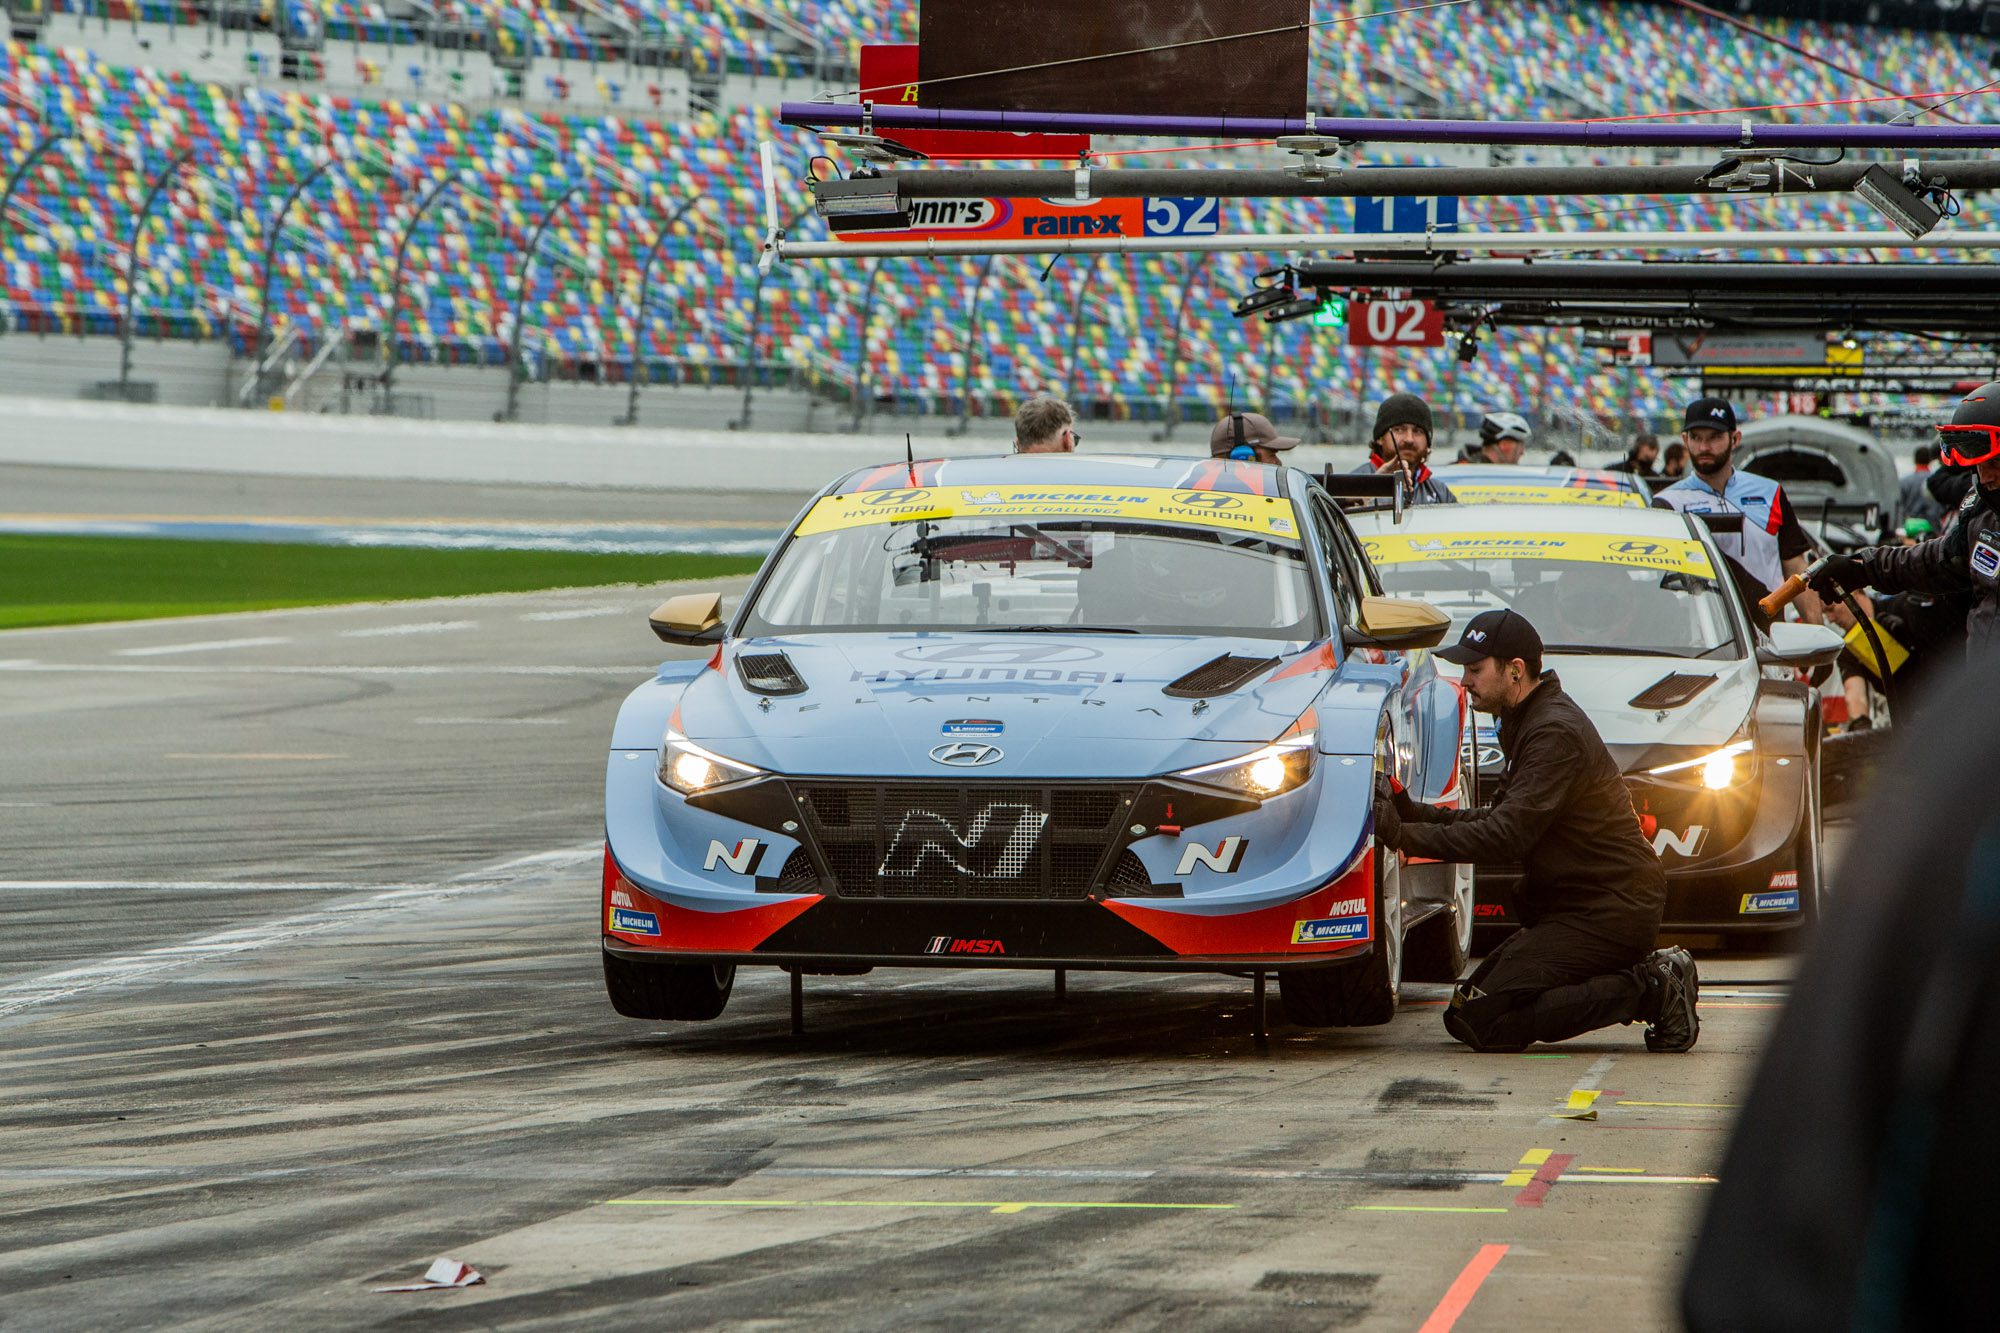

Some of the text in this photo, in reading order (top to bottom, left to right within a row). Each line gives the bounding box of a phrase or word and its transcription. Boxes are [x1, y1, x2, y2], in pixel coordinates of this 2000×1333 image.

[1146, 197, 1217, 234] 52
[1367, 299, 1426, 342] 02
[1010, 493, 1149, 505] MICHELIN
[843, 504, 936, 519] HYUNDAI
[979, 504, 1123, 515] PILOT CHALLENGE
[1159, 506, 1254, 523] HYUNDAI
[1450, 539, 1566, 548] MICHELIN
[1470, 550, 1546, 558] CHALLENGE
[1601, 555, 1682, 566] HYUNDAI
[849, 667, 1126, 684] HYUNDAI
[1769, 873, 1798, 887] MOTUL
[610, 889, 633, 908] MOTUL
[1758, 896, 1795, 908] MICHELIN
[1329, 897, 1367, 917] MOTUL
[621, 916, 654, 929] MICHELIN
[1315, 923, 1363, 936] MICHELIN
[950, 939, 1006, 954] IMSA
